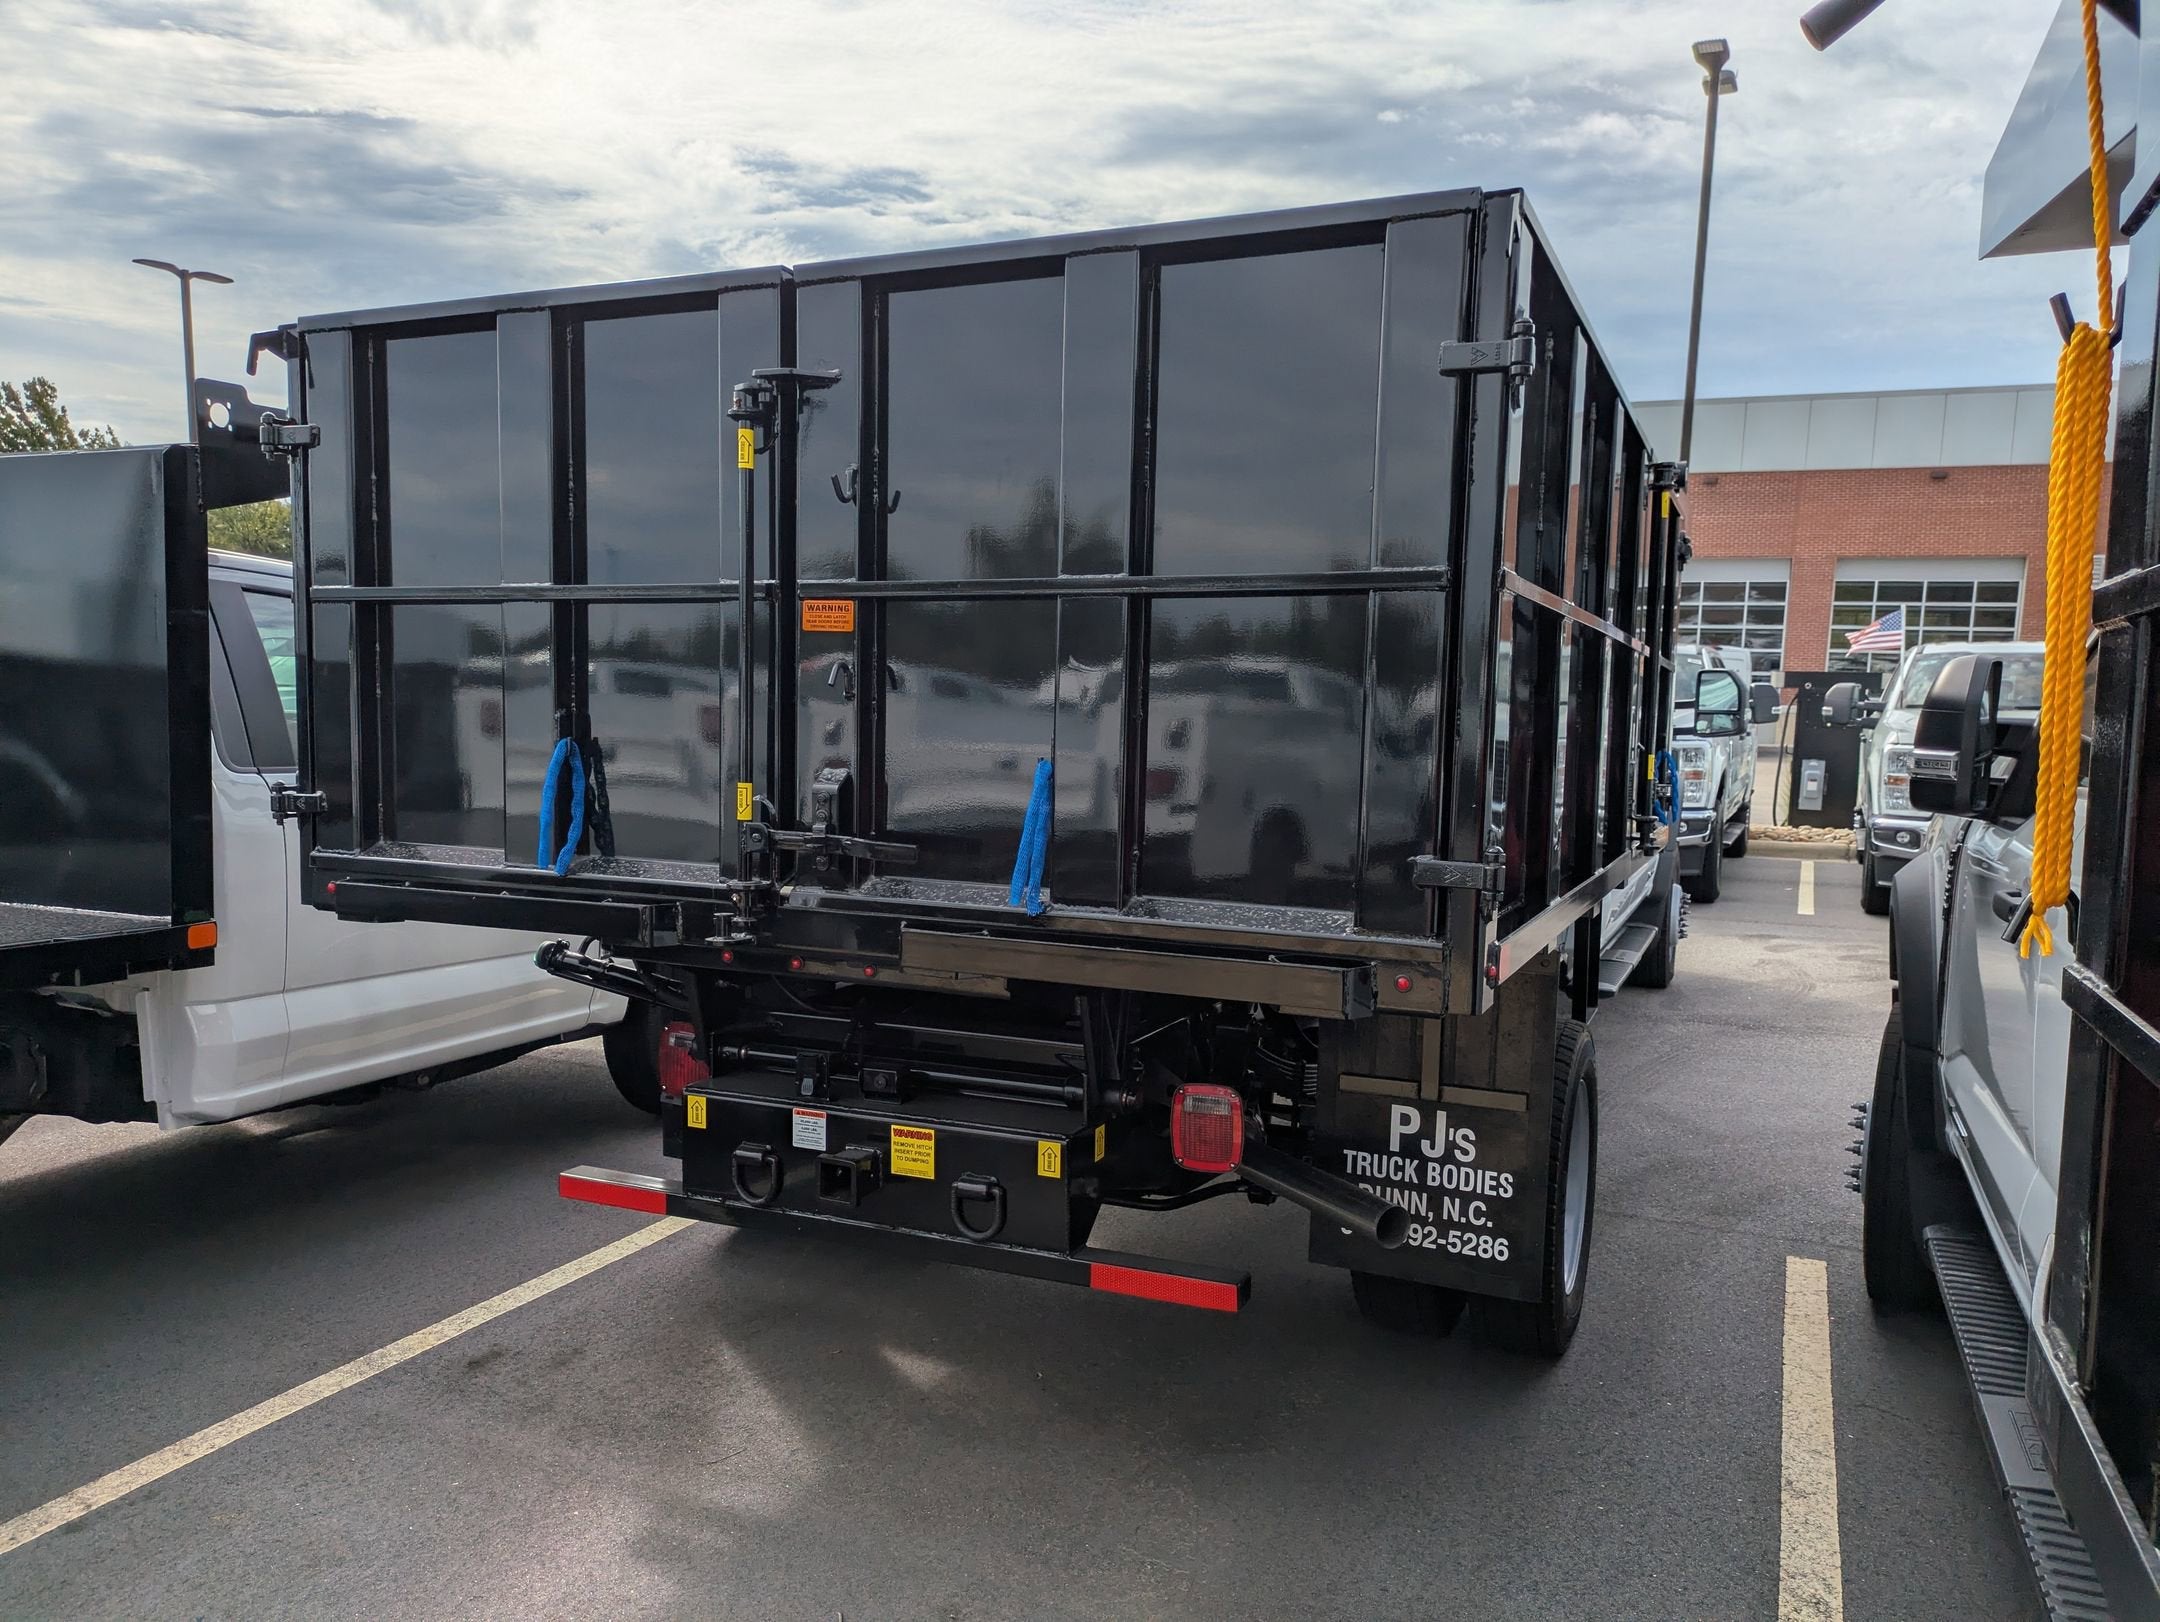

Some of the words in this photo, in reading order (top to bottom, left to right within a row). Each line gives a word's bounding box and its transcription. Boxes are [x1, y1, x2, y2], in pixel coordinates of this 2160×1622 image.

[806, 604, 850, 613] WARNING
[893, 1127, 934, 1142] WARNING
[893, 1141, 915, 1149] REMOVE
[916, 1143, 933, 1151] HITCH
[893, 1148, 914, 1156] INSERT
[914, 1150, 931, 1158] PRIOR
[904, 1156, 930, 1165] DUMPING
[1343, 1149, 1419, 1184] TRUCK
[1427, 1162, 1514, 1199] BODIES
[1443, 1196, 1493, 1228] N.C.
[1402, 1223, 1510, 1262] 92-5286
